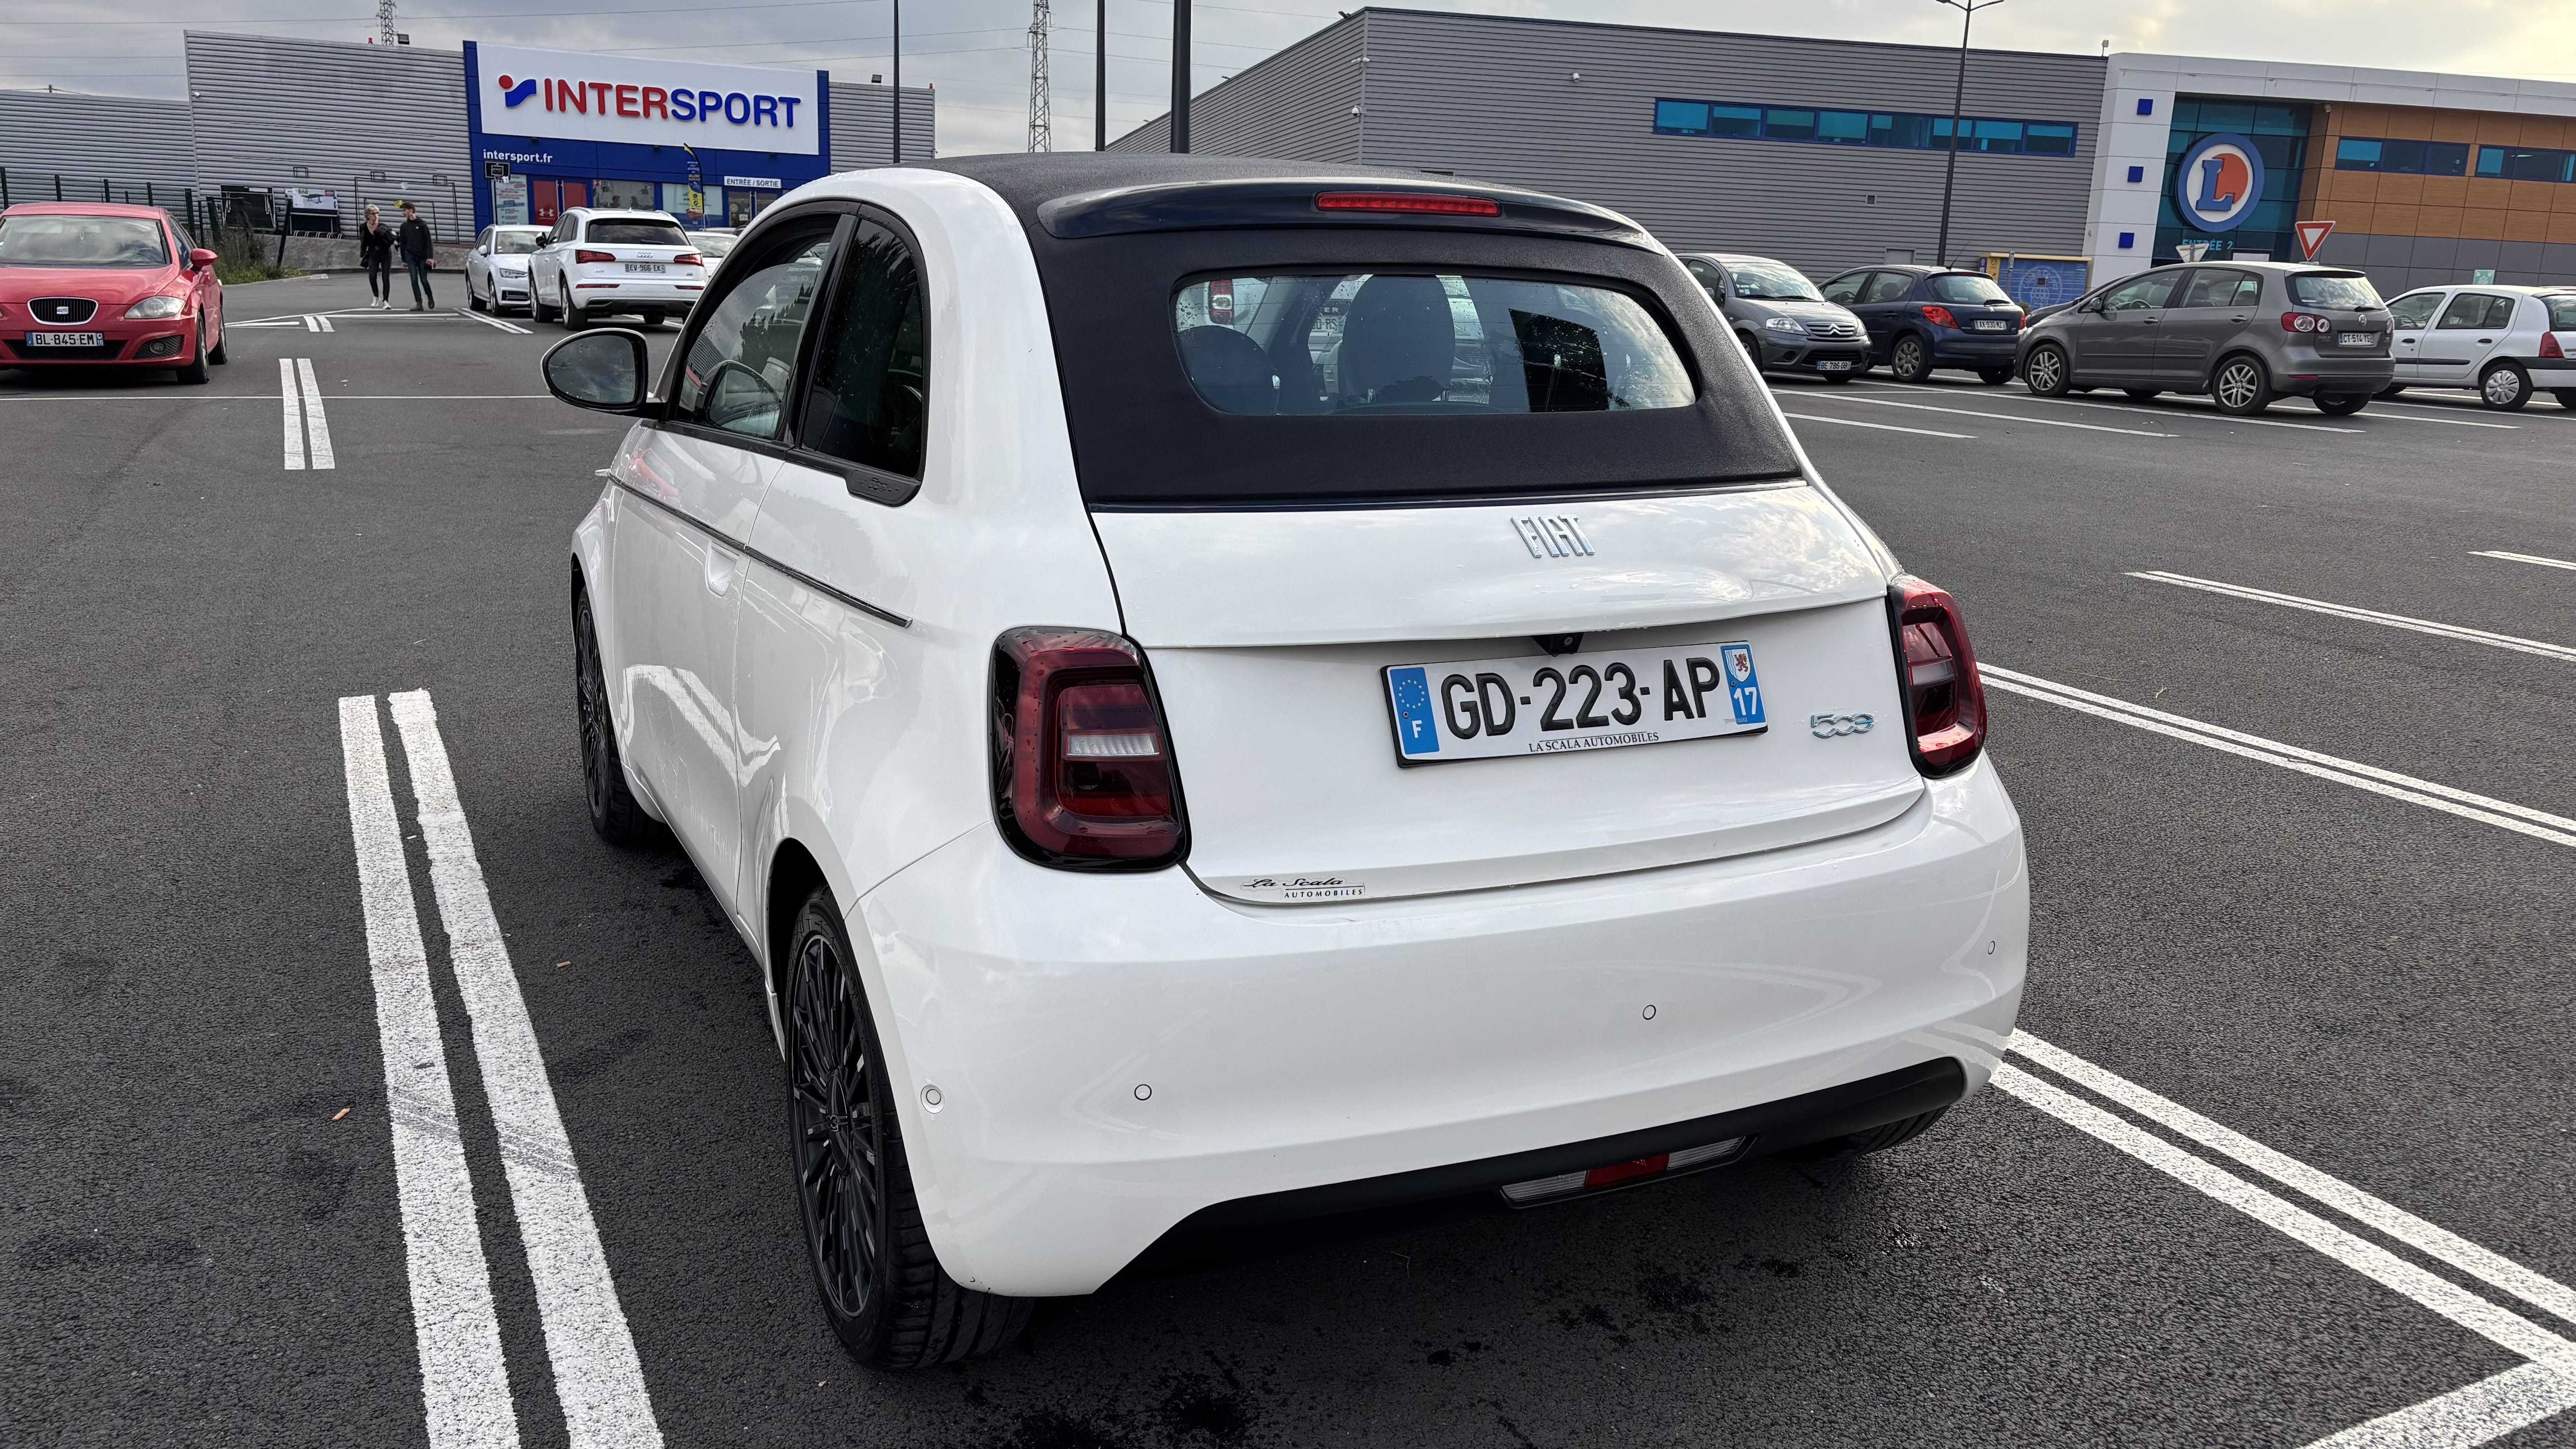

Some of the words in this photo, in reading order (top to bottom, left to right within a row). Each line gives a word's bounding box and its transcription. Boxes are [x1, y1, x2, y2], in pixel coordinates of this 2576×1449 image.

[544, 77, 801, 128] INTERSPORT
[483, 148, 553, 164] intersport.fr
[2195, 160, 2234, 211] L
[2226, 240, 2234, 250] 2
[36, 334, 95, 345] BL-845-EM
[1510, 514, 1596, 558] FIAT
[1411, 720, 1422, 739] F
[1441, 656, 1720, 740] GD-223-AP
[1733, 686, 1757, 716] 17
[1529, 742, 1544, 752] LA
[1546, 739, 1581, 751] SCALA
[1583, 731, 1660, 748] AUTOMOBILES
[1243, 878, 1278, 887] La
[1283, 877, 1344, 887] Scala
[1283, 888, 1363, 899] AUTOMOBILES
